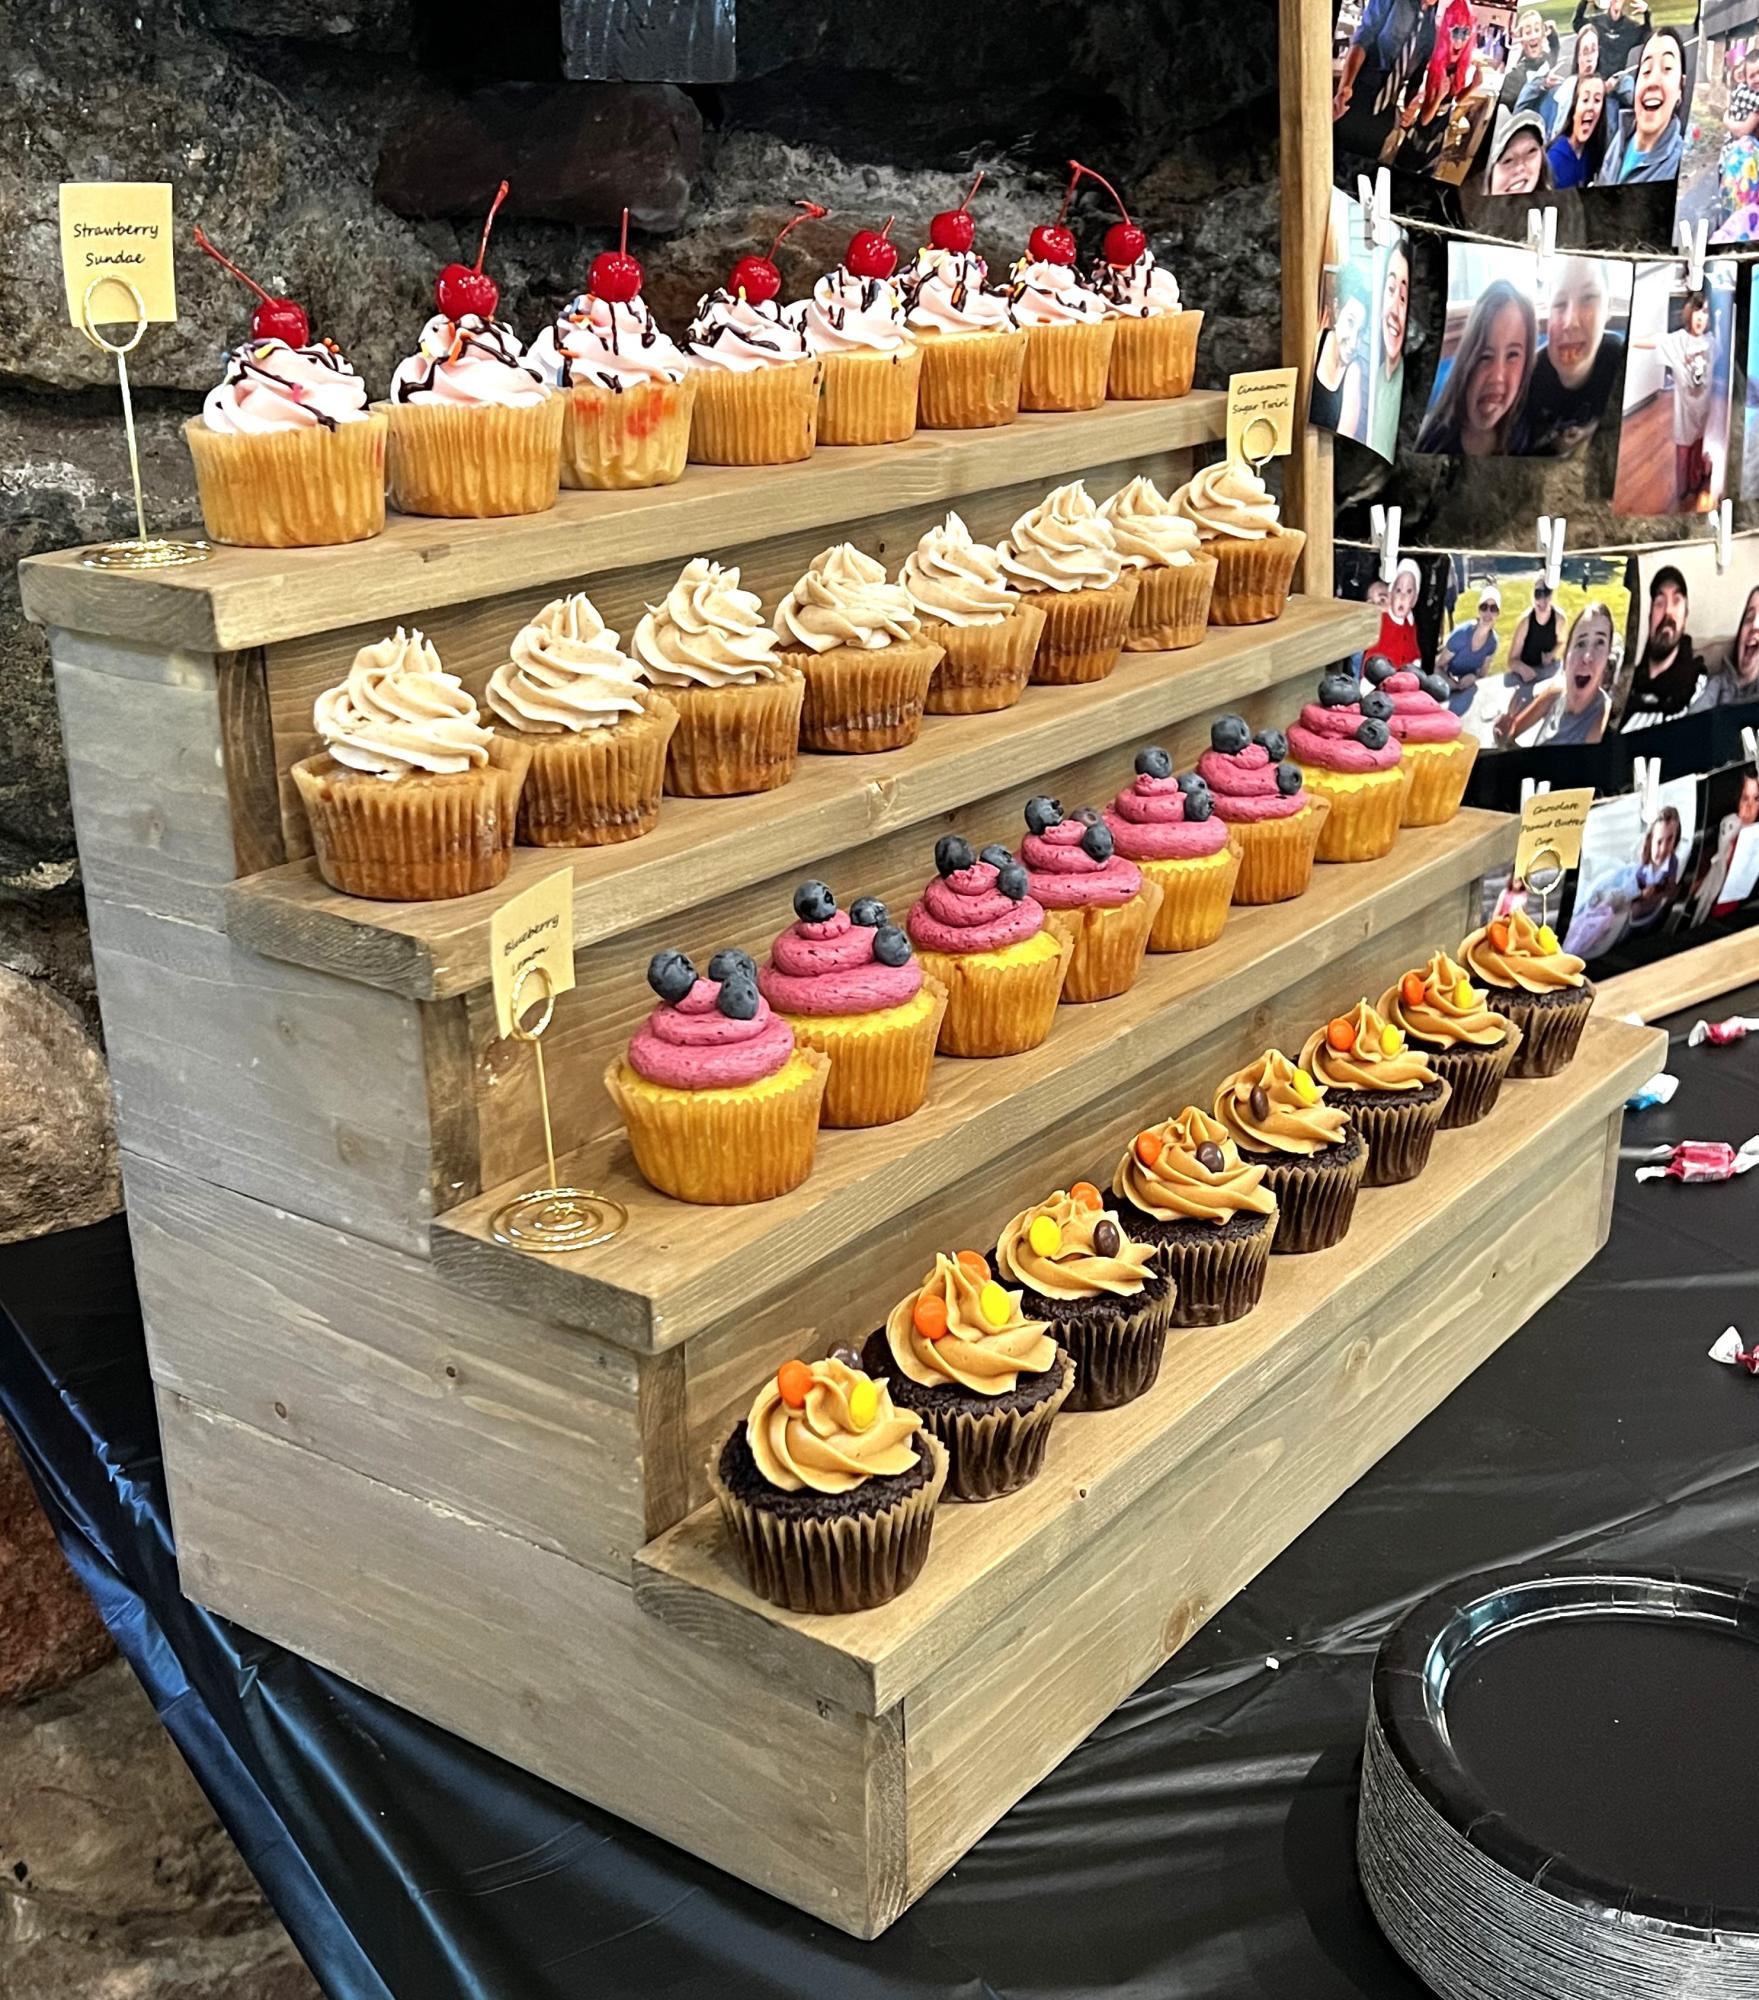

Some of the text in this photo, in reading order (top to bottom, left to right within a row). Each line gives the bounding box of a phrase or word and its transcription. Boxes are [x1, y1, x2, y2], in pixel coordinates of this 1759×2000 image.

[73, 221, 159, 239] Strawberry
[86, 250, 146, 267] Sundae
[1237, 383, 1289, 395] Cinnamon
[1232, 403, 1258, 415] Sugar
[1533, 802, 1579, 815] Chocolate
[1554, 818, 1586, 828] Butter
[1534, 837, 1555, 847] Cup
[504, 914, 560, 956] Blueberry
